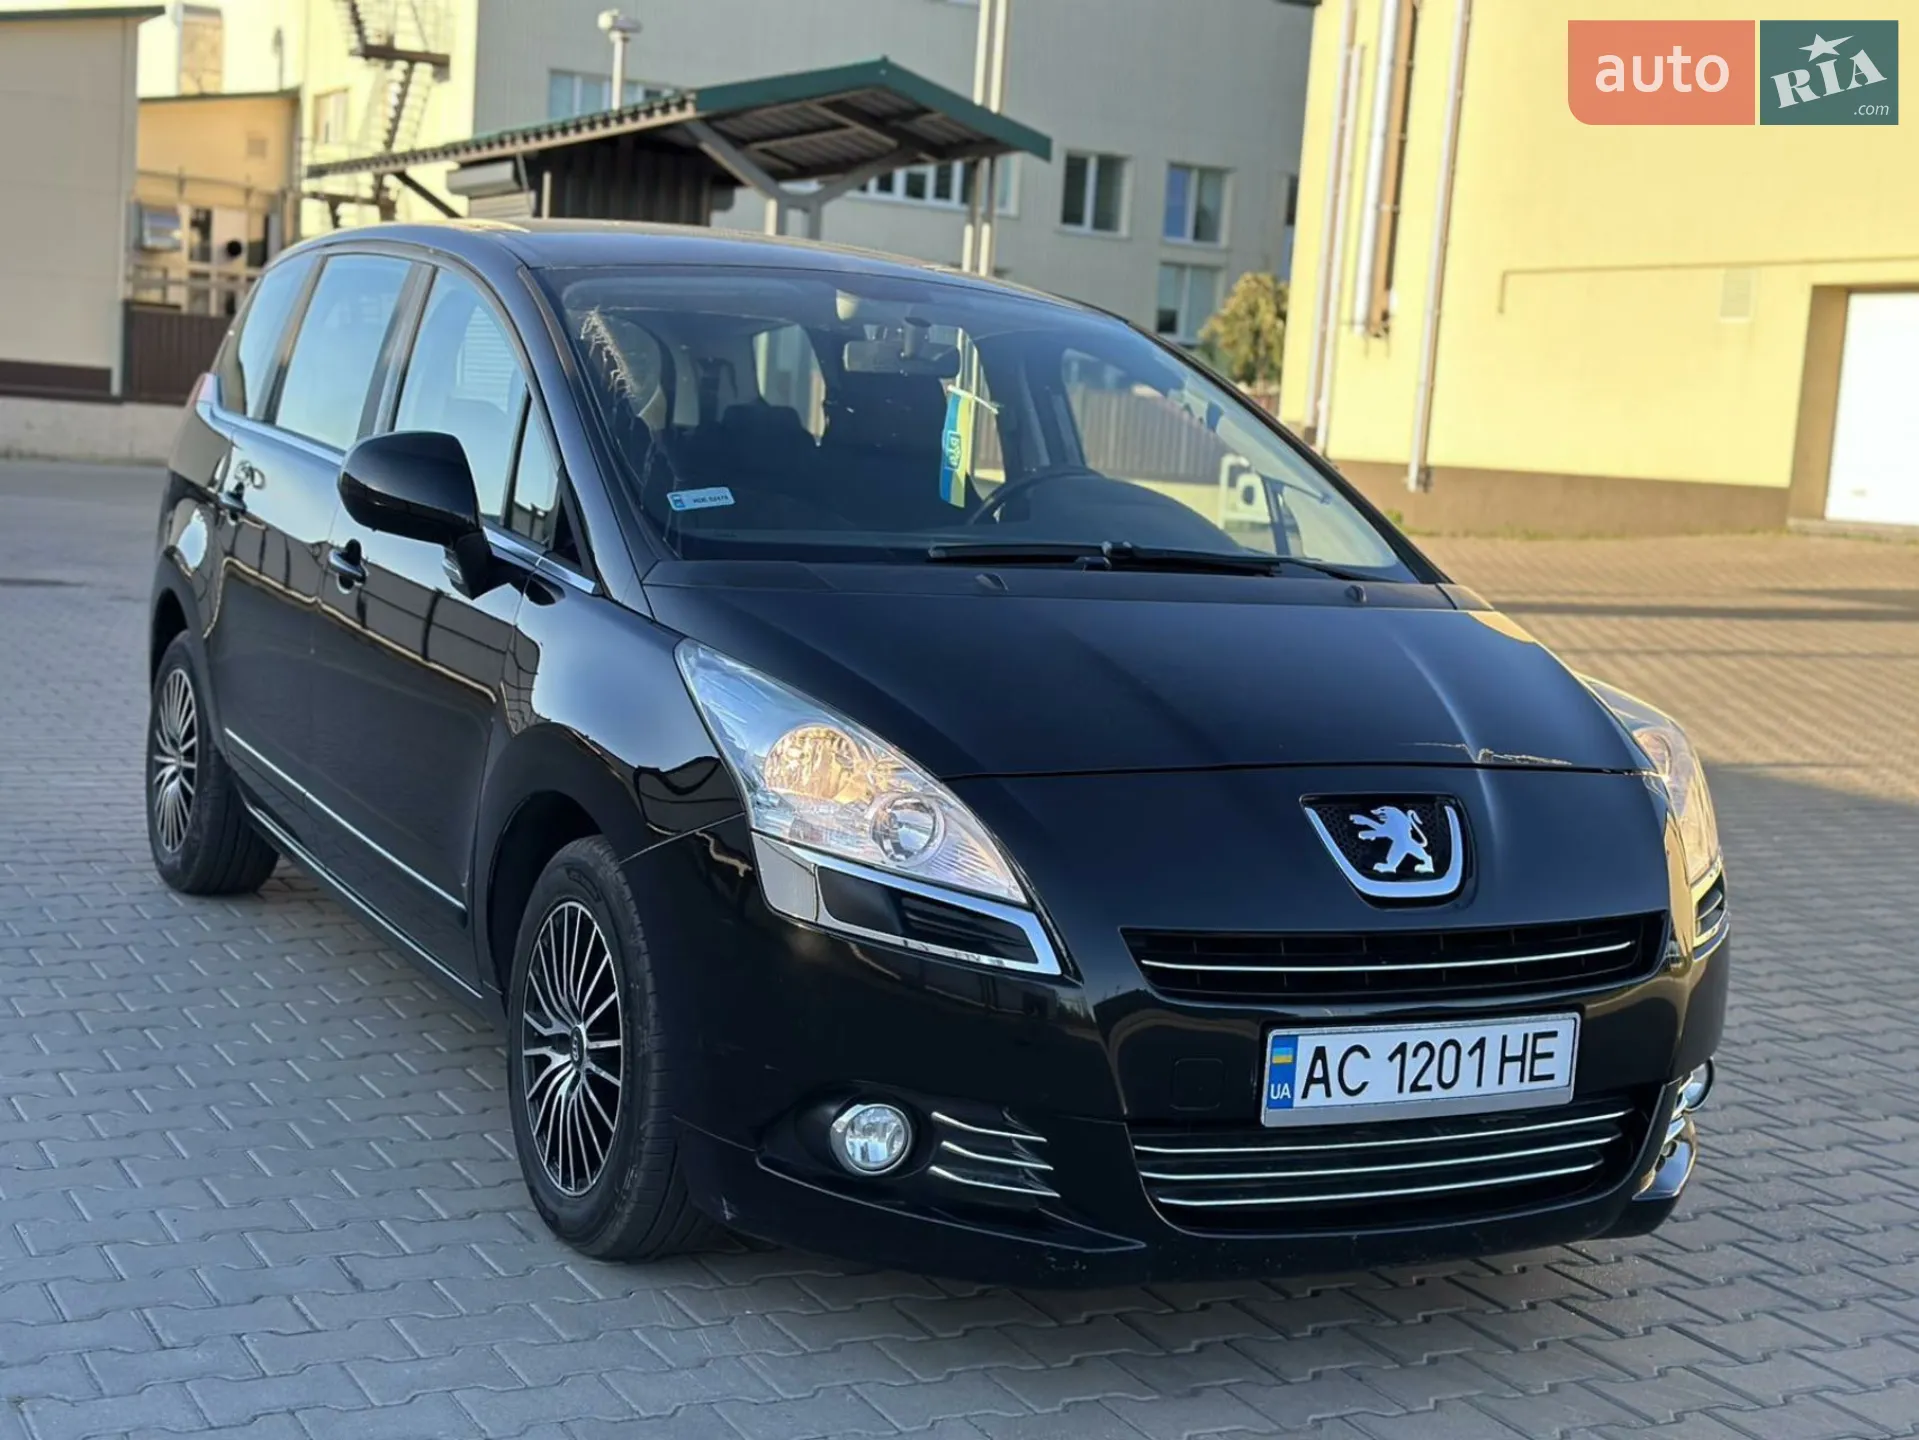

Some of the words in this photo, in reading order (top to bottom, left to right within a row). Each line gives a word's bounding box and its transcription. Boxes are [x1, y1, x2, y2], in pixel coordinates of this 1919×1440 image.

[1301, 1044, 1371, 1099] AC
[1388, 1036, 1487, 1094] 1201
[1498, 1030, 1558, 1085] HE
[1269, 1083, 1292, 1100] UA
